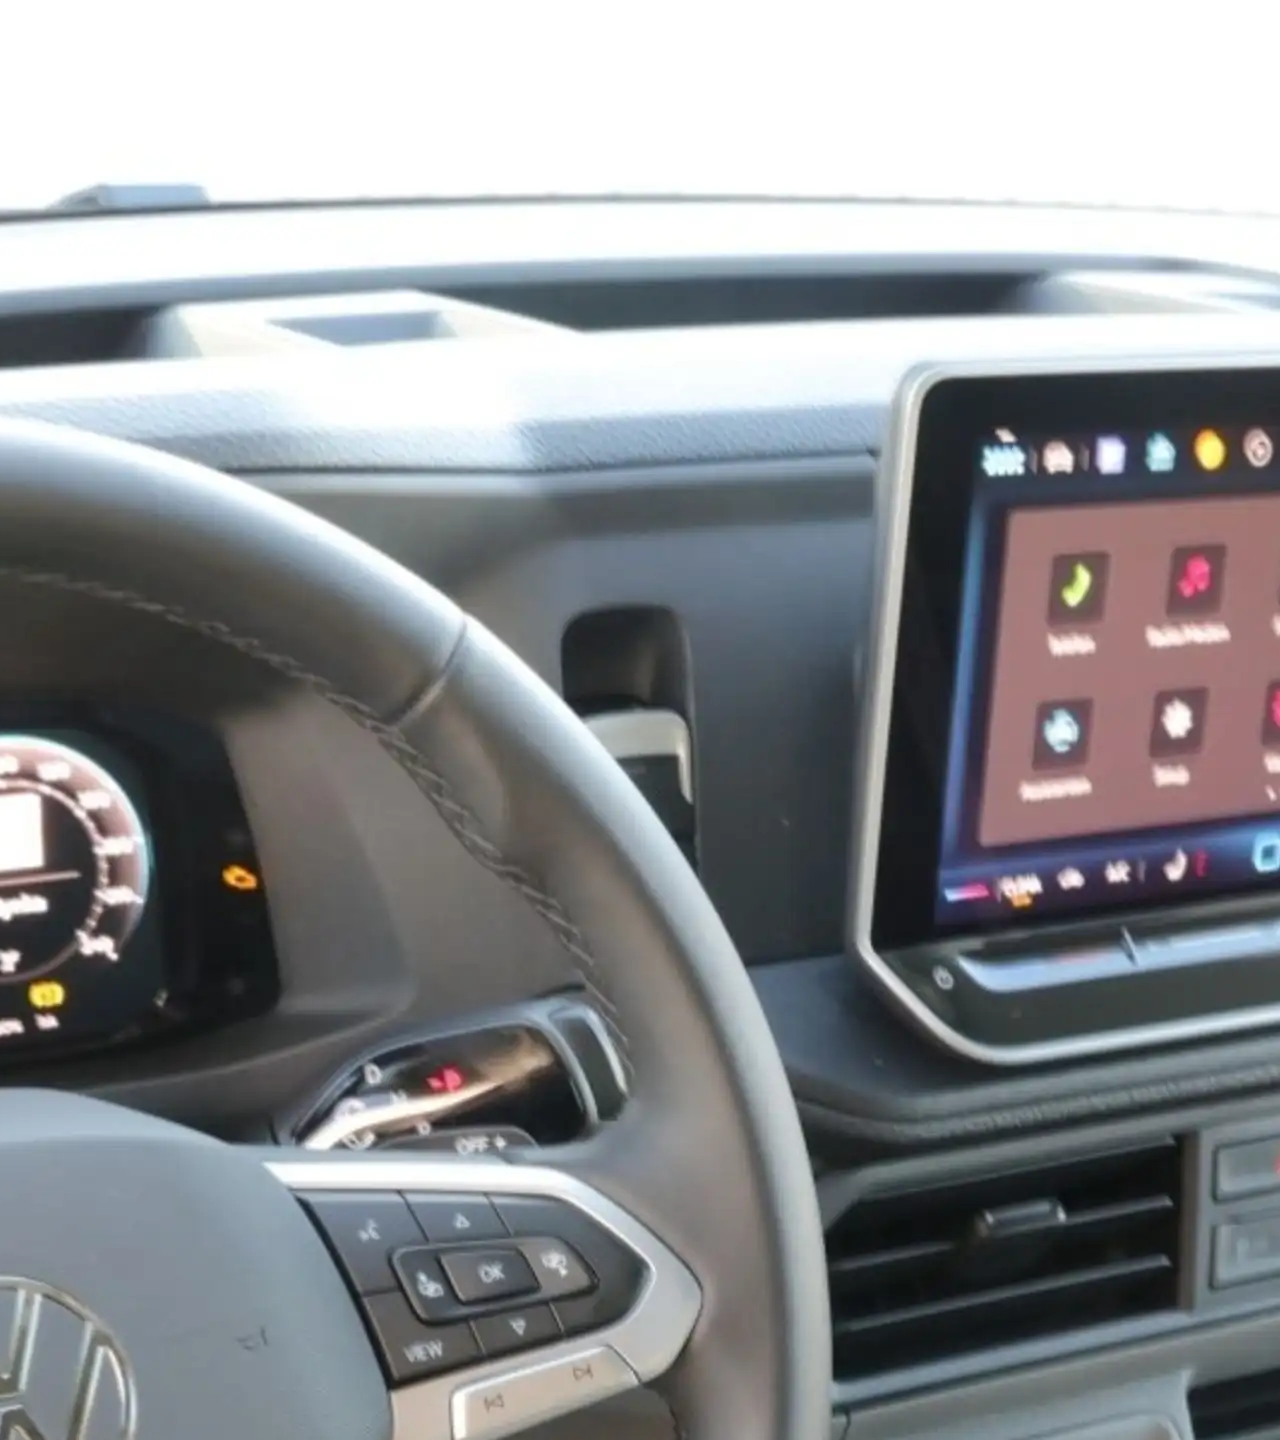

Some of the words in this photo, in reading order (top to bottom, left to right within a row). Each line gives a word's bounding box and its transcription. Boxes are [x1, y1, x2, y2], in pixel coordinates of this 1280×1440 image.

[455, 1134, 492, 1156] OFF
[478, 1261, 506, 1284] OK
[402, 1340, 445, 1364] VIEW
